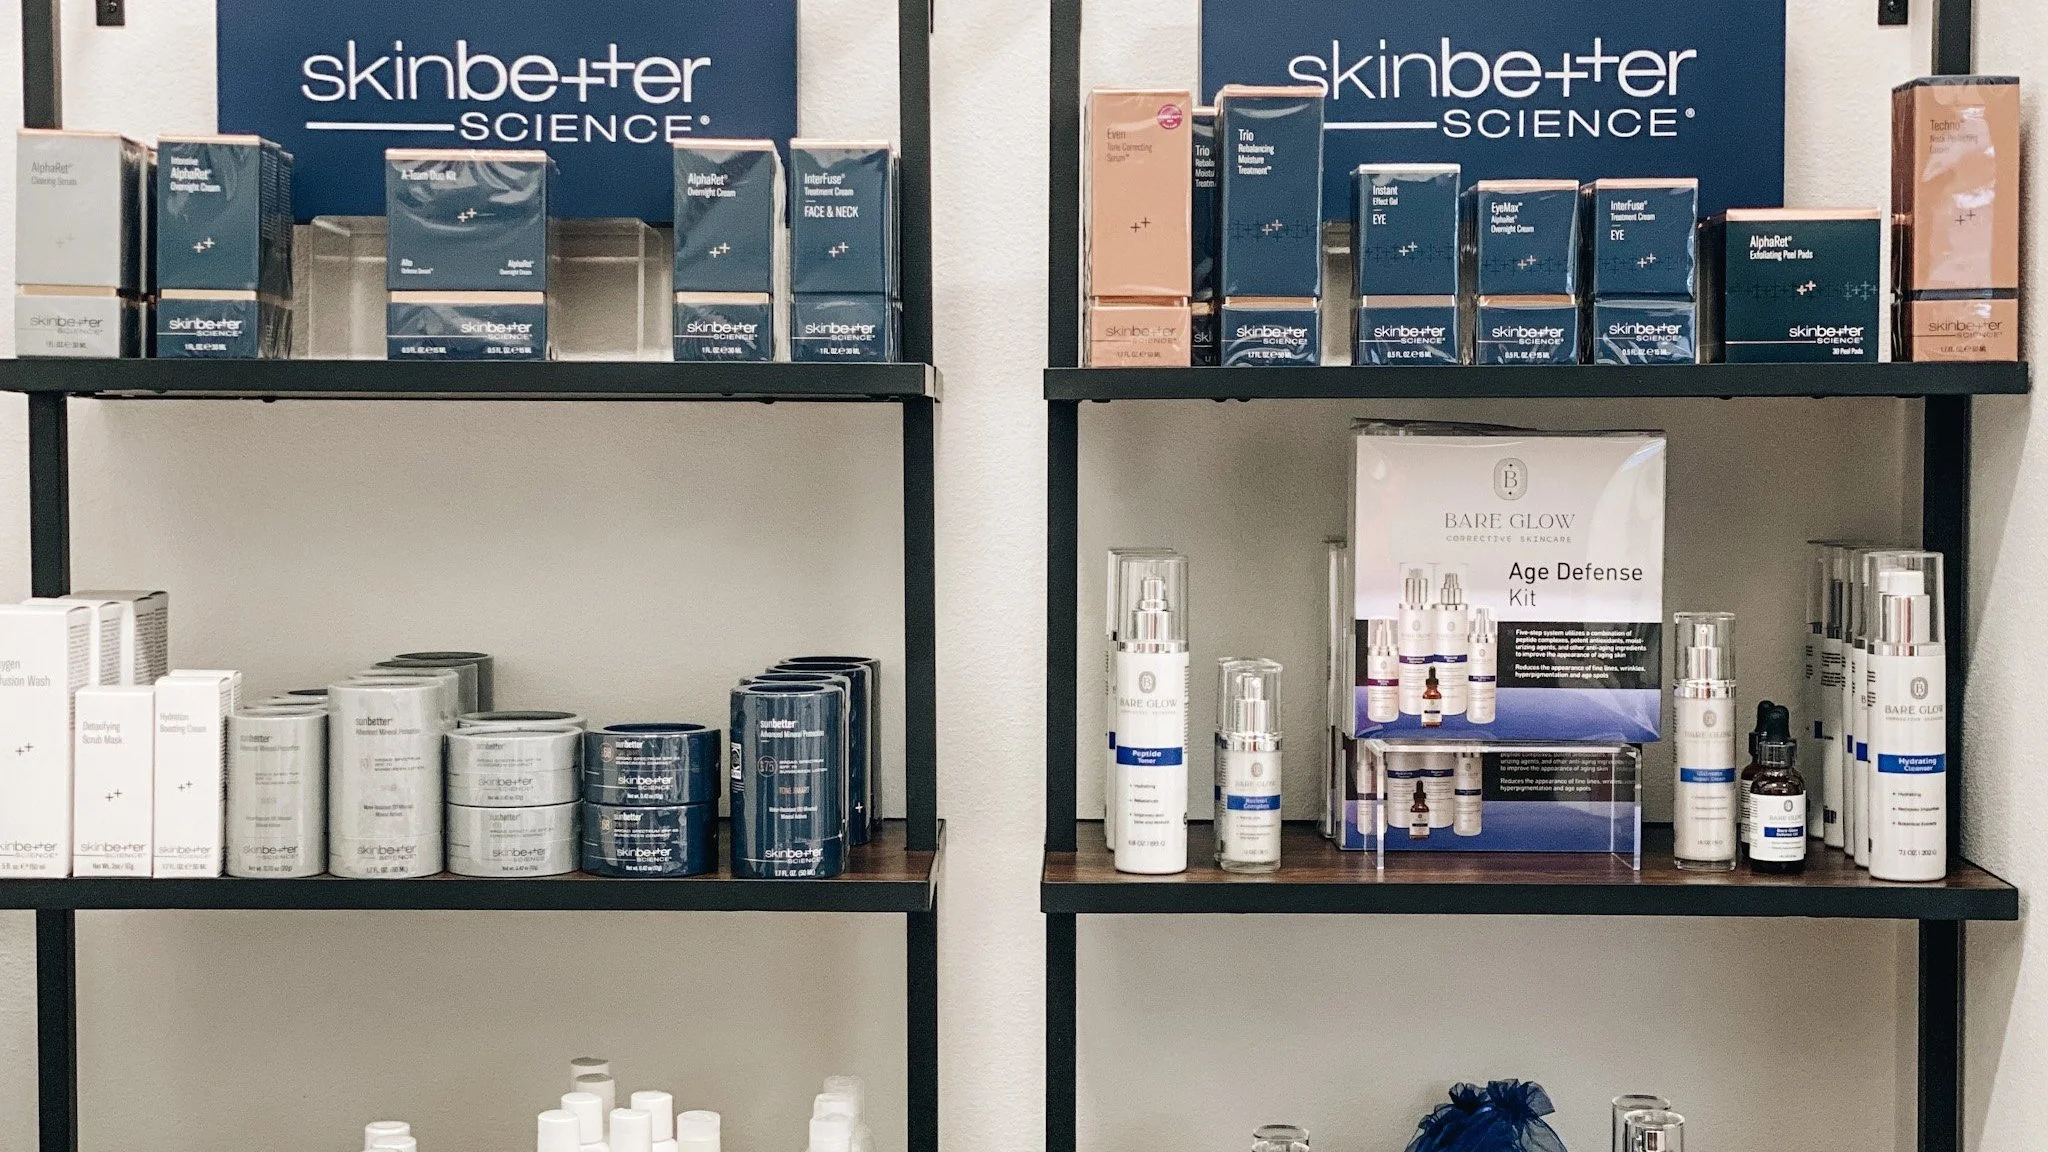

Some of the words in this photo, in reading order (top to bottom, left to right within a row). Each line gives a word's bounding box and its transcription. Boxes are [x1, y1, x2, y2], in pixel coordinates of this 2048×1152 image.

[1107, 128, 1126, 140] Even
[1238, 129, 1254, 142] Trio
[1195, 145, 1210, 156] Trio
[1238, 144, 1274, 156] Rebalancing
[1238, 156, 1264, 164] Moisture
[688, 187, 716, 198] Overnight
[717, 188, 736, 198] Cream
[804, 187, 834, 196] Treatment
[834, 187, 854, 196] Cream
[1373, 185, 1398, 196] Instant
[1373, 197, 1388, 206] Effect
[804, 206, 824, 218] FACE
[826, 206, 834, 218] &
[836, 206, 859, 218] NECK
[1610, 213, 1638, 221] Treatment
[1638, 213, 1656, 221] Cream
[1373, 214, 1386, 225] EYE
[1490, 225, 1516, 234] Overnight
[1516, 225, 1534, 234] Cream
[1610, 230, 1624, 240] EYE
[1750, 250, 1782, 260] Exfoliating
[1783, 250, 1796, 259] Peel
[1798, 250, 1813, 260] Pads
[1840, 347, 1850, 355] Peel
[1850, 347, 1864, 355] Pads
[1445, 512, 1502, 529] BARE
[1510, 512, 1576, 530] GLOW
[1446, 535, 1512, 543] CORRECTIVE
[1520, 536, 1572, 544] SKINCARE
[1509, 562, 1549, 584] Age
[1557, 562, 1644, 582] Defense
[1508, 588, 1537, 607] Kit
[1516, 629, 1542, 638] Five-step
[1544, 629, 1564, 638] system
[1516, 636, 1537, 645] peptide
[1570, 636, 1588, 645] potent
[1516, 644, 1535, 652] urizing
[1586, 644, 1614, 652] anti-aging
[1615, 644, 1646, 652] ingredients
[28, 676, 50, 686] Wash
[1515, 672, 1568, 680] hyperpigmentation
[1593, 672, 1608, 680] spots
[1120, 699, 1143, 708] BARE
[1146, 699, 1177, 708] GLOW
[1885, 704, 1916, 714] BARE
[82, 720, 120, 732] Detoxifying
[760, 718, 798, 728] sunbetter
[82, 735, 102, 744] Scrub
[104, 735, 122, 744] Mask
[1132, 750, 1162, 759] Peptide
[1898, 756, 1936, 767] Hydrating
